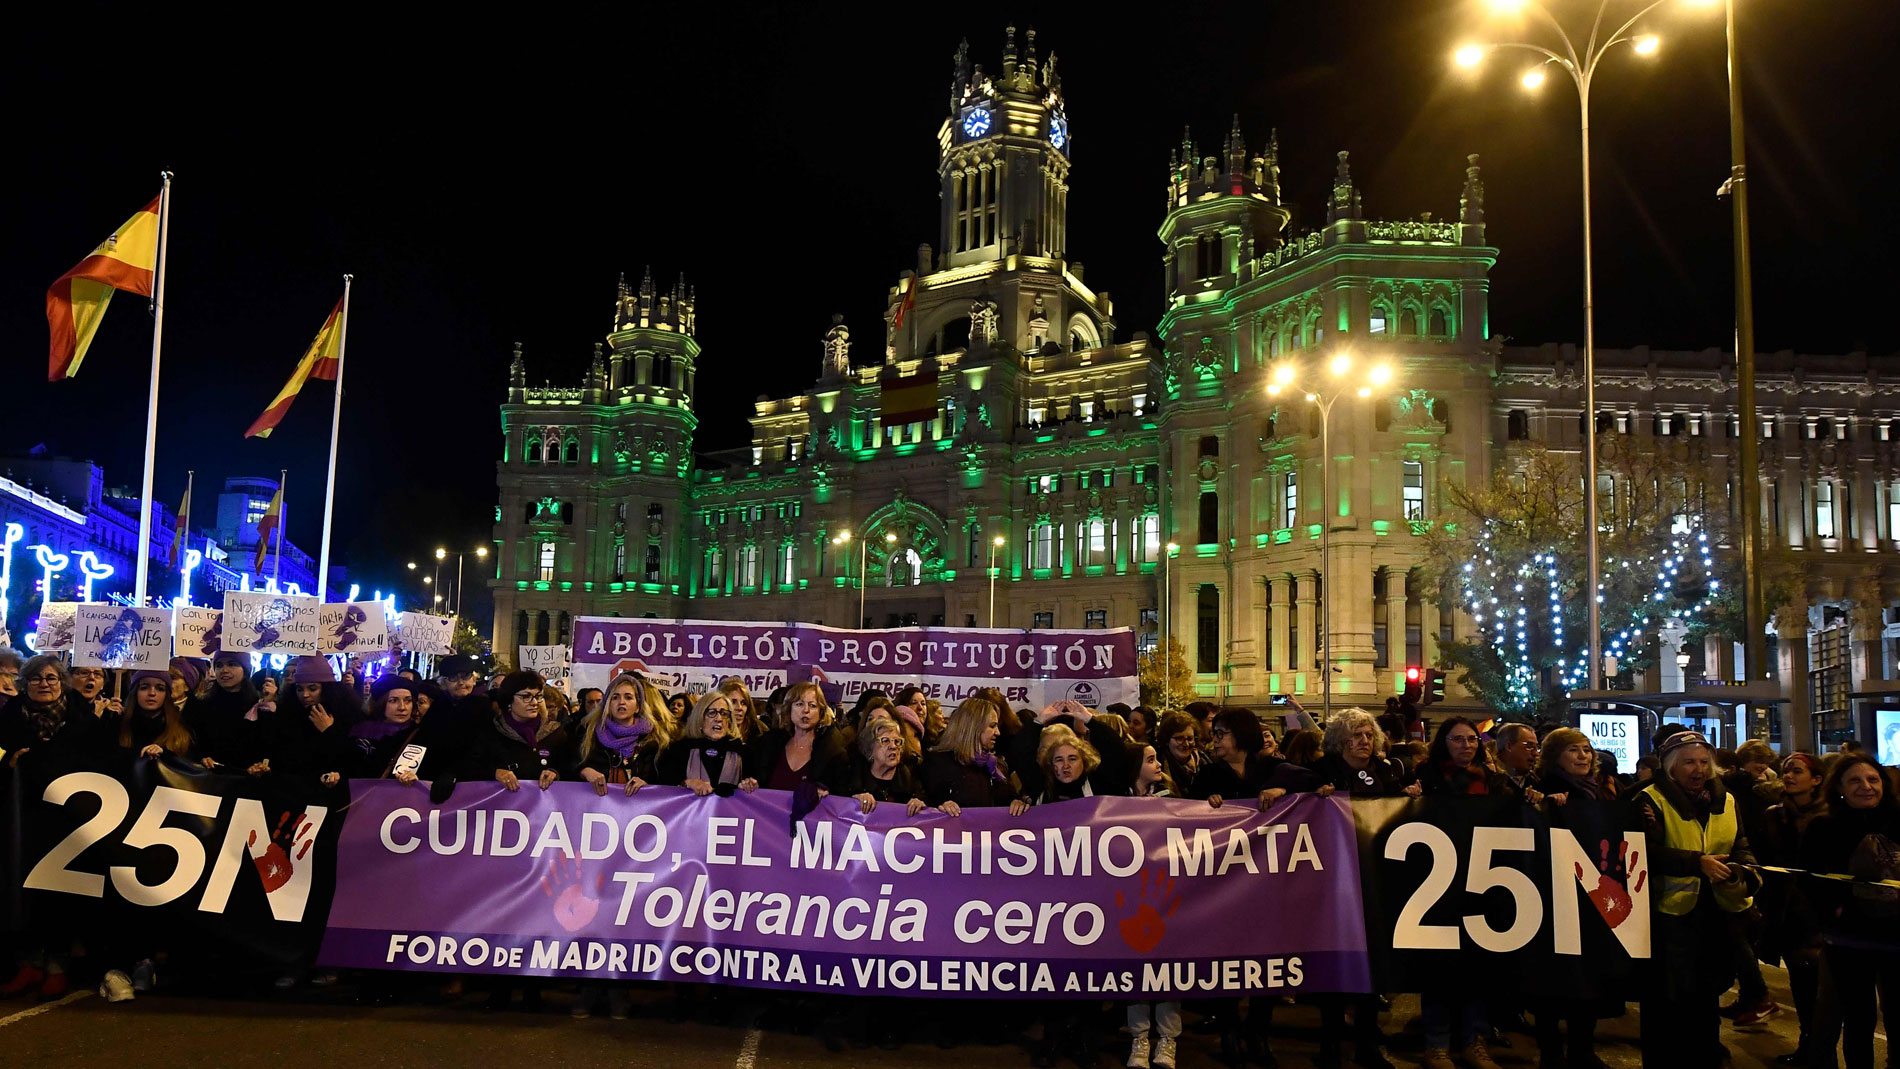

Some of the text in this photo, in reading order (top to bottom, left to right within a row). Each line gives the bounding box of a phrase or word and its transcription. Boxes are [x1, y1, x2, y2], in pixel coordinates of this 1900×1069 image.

[232, 599, 252, 613] No
[328, 624, 364, 637] SR
[412, 615, 434, 629] NOS
[129, 629, 162, 647] AVES
[402, 626, 451, 643] QUEREMOS
[588, 630, 1114, 670] ABOLICIÓN PROSTITUCIÓN
[921, 682, 940, 698] DE
[1592, 722, 1626, 738] NO ES
[23, 772, 327, 922] 25N
[379, 807, 1325, 877] CUIDADO, EL MACHISMO MATA
[1384, 821, 1652, 959] 25N
[611, 871, 1105, 946] Tolerancia cero
[386, 934, 1304, 992] FORO DE MADRID CONTRA LA VIOLENCIA A LAS MUJERES
